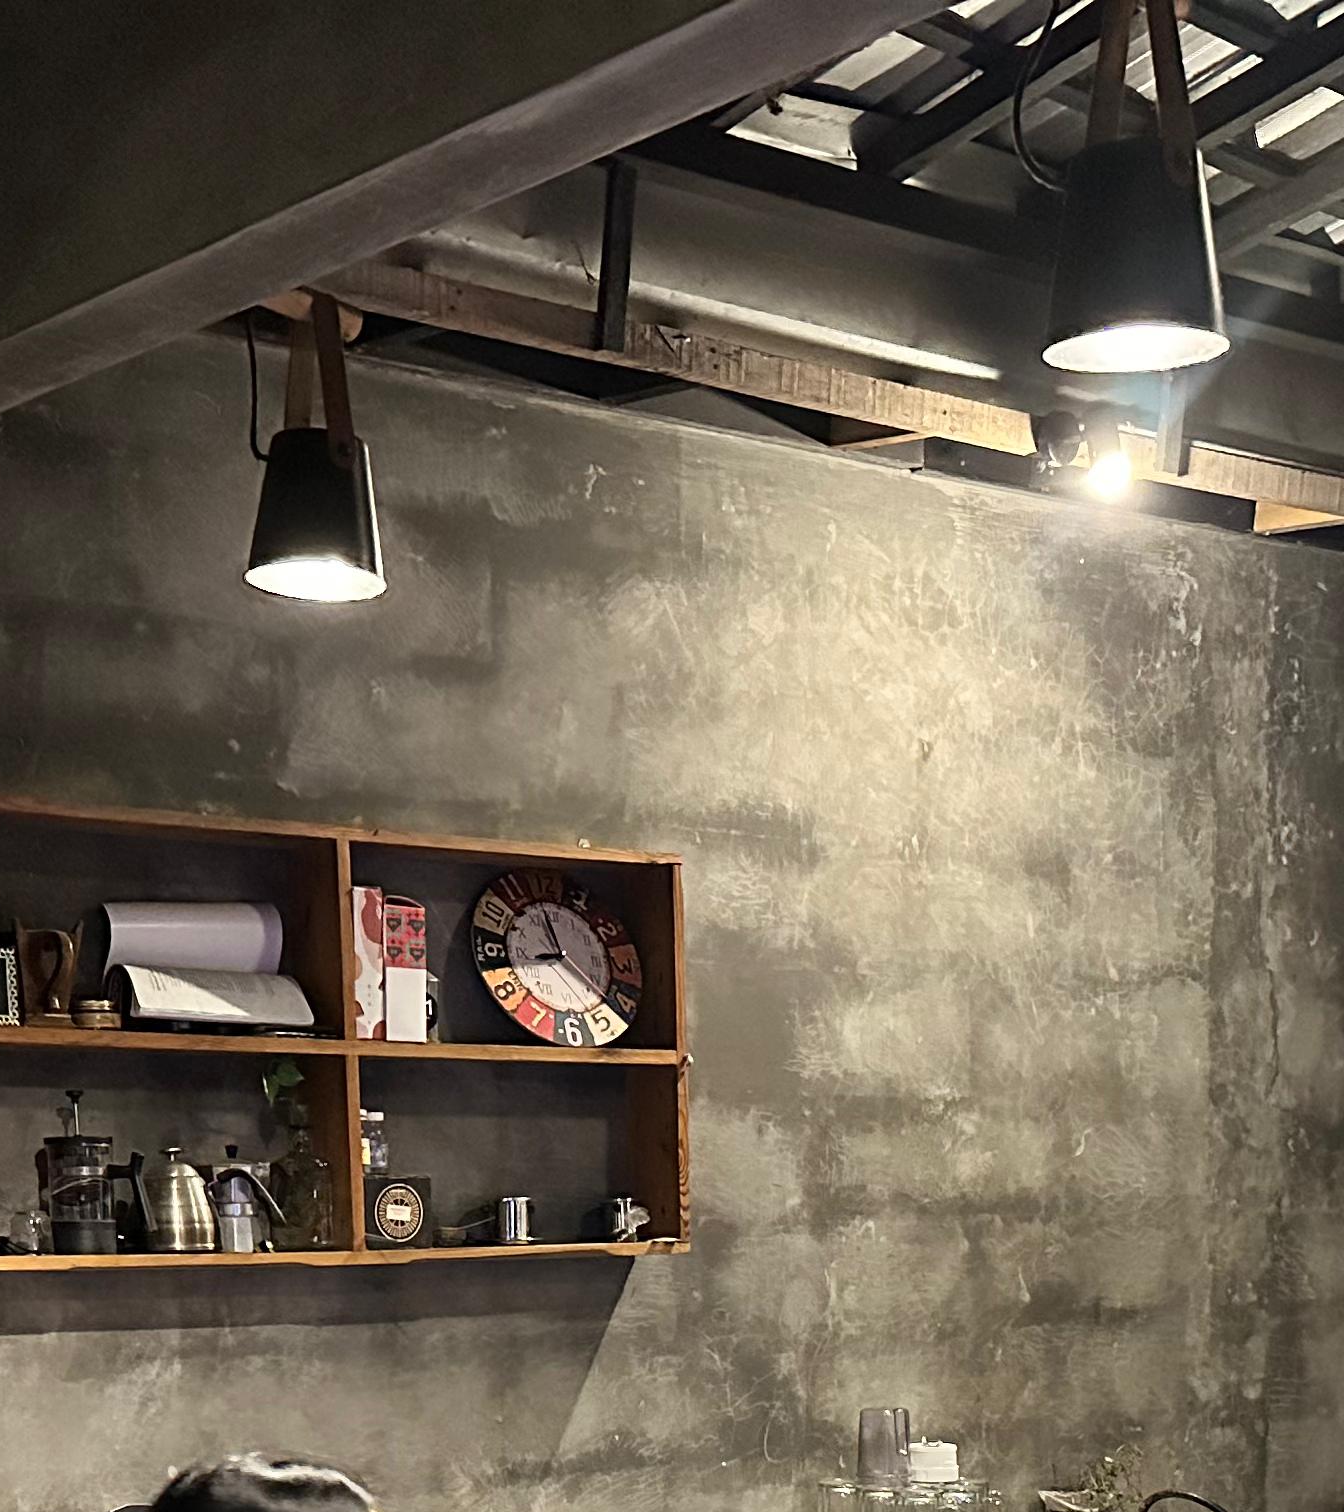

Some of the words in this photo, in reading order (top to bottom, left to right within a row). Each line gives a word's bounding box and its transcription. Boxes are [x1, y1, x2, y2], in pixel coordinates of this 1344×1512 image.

[482, 902, 504, 927] 10
[598, 924, 618, 941] 2
[494, 980, 516, 1001] 8
[530, 1002, 547, 1027] 7
[590, 1009, 611, 1033] 5
[563, 1017, 583, 1047] 6
